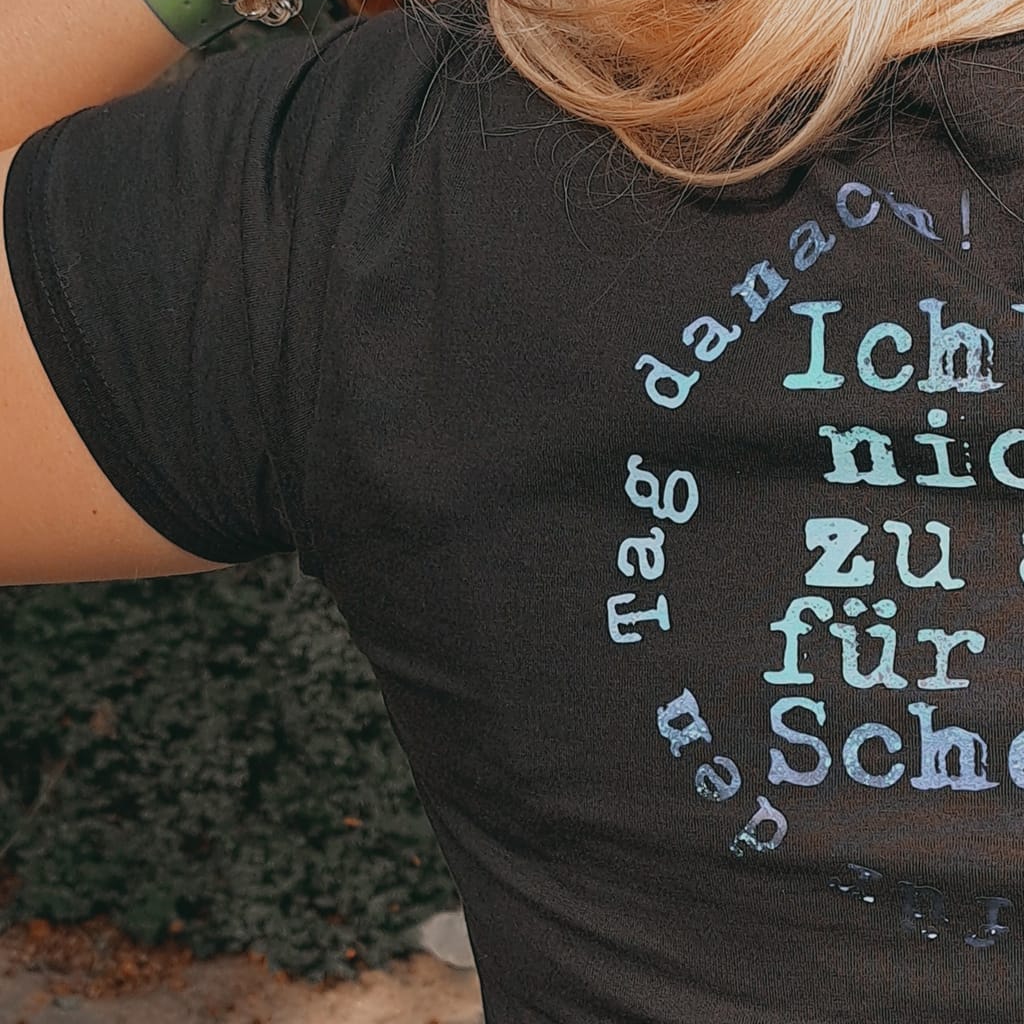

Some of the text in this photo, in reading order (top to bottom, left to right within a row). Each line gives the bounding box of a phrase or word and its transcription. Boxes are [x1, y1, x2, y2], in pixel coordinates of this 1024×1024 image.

[782, 298, 1004, 393] Ich
[606, 454, 699, 645] Tag
[804, 515, 966, 592] zu
[762, 595, 986, 691] für
[656, 688, 789, 856] den
